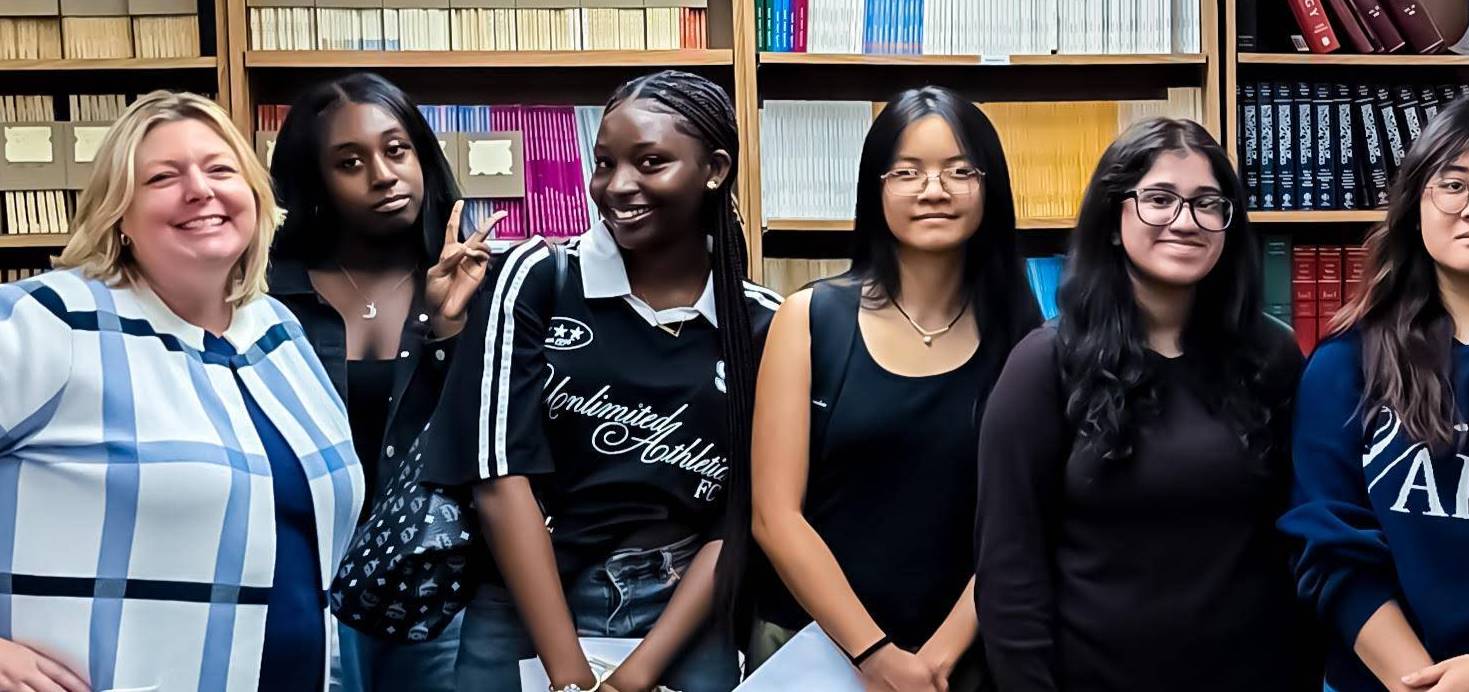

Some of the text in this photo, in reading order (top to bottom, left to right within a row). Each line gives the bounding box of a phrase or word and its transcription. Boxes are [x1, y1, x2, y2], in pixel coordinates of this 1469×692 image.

[543, 362, 689, 432] Unlimited
[591, 421, 730, 481] Athletic
[693, 479, 722, 502] FC
